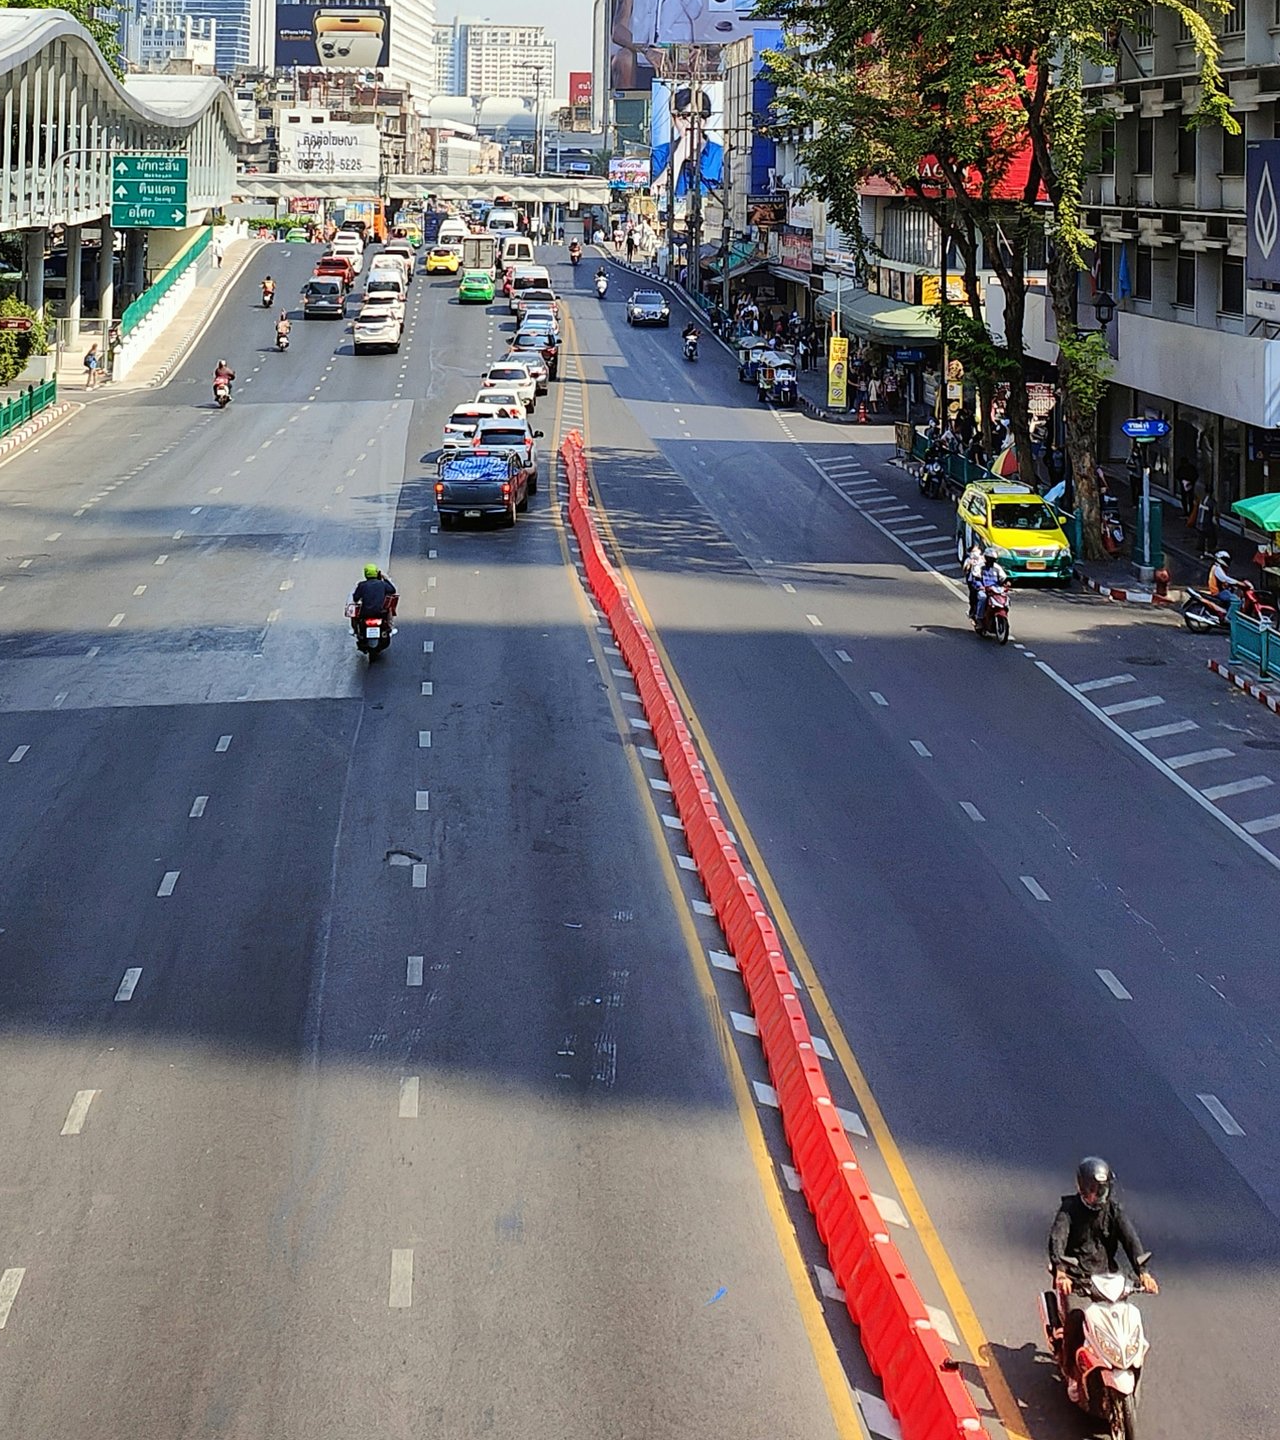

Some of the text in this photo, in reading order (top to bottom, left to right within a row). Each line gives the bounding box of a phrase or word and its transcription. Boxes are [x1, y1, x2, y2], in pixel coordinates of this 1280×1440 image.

[136, 159, 180, 172] มักกะสัน
[139, 183, 176, 194] ดินแดง
[128, 205, 155, 218] อโศก
